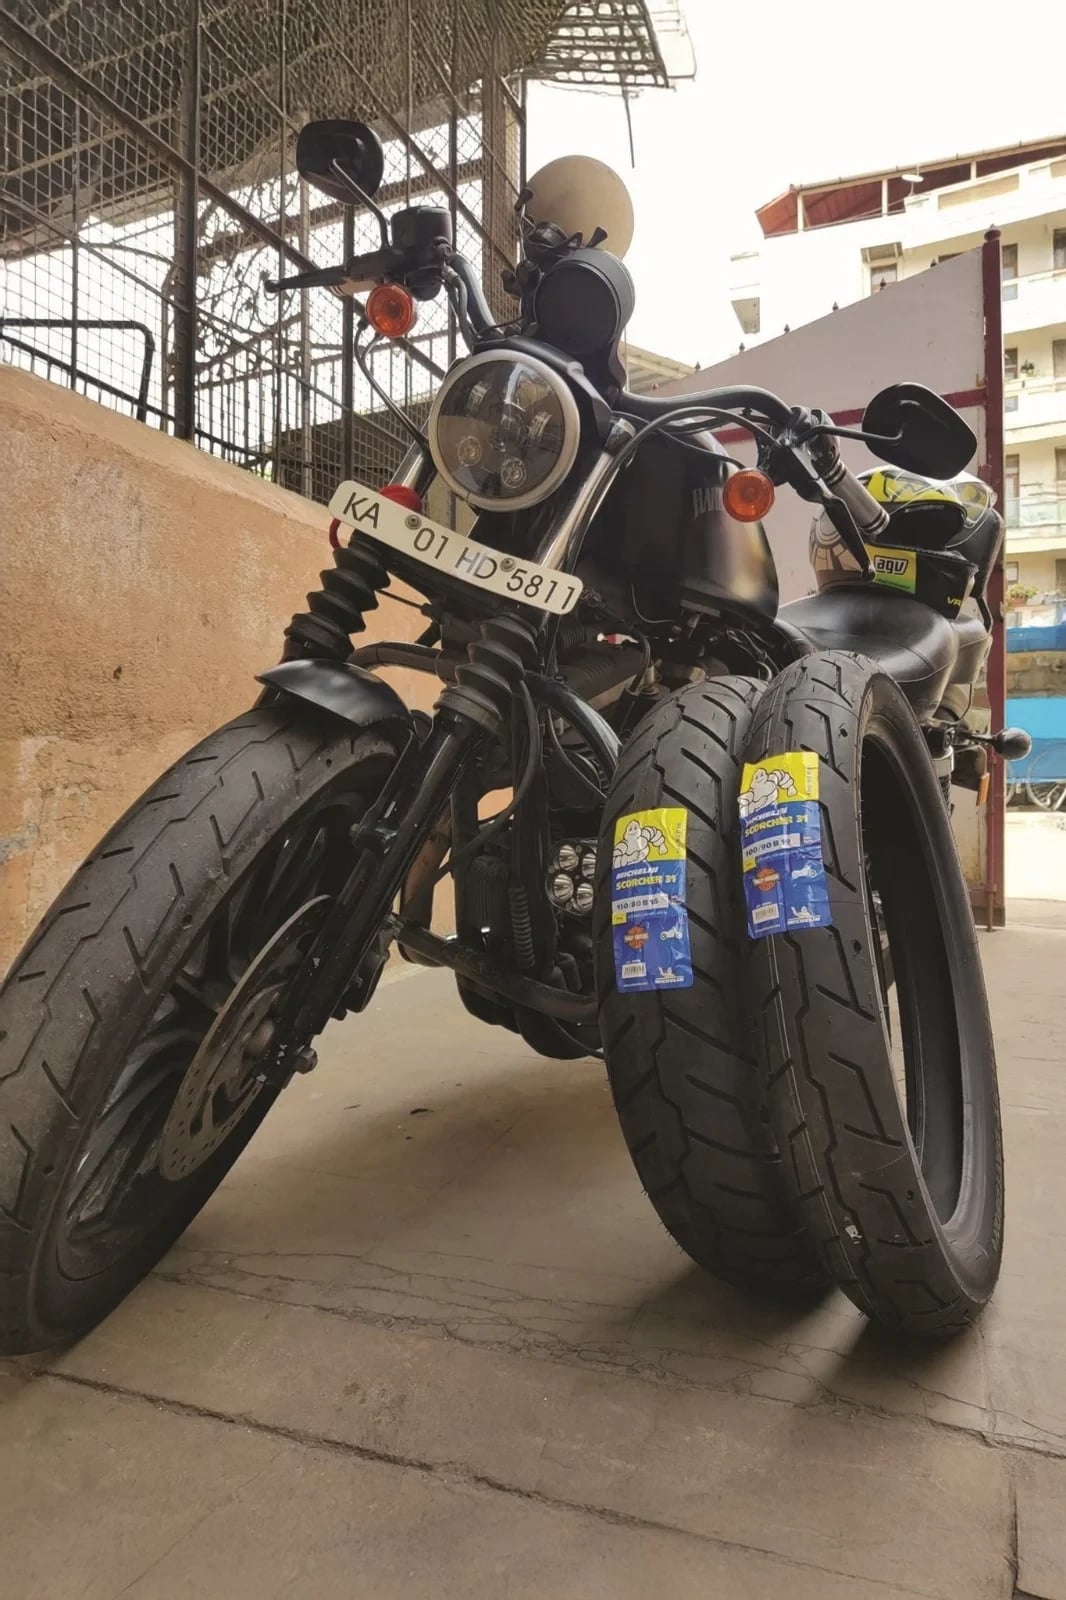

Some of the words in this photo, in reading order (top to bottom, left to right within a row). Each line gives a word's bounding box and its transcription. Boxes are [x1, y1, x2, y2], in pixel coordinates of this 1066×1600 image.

[343, 491, 380, 529] KA
[413, 527, 449, 560] 01
[454, 547, 498, 580] HD
[506, 568, 576, 610] 5811
[876, 558, 904, 573] agv
[744, 815, 793, 838] SCORCHER
[795, 814, 809, 823] 31
[616, 866, 659, 880] MICHELIN
[615, 875, 662, 891] SCORCHER
[664, 874, 677, 883] 31
